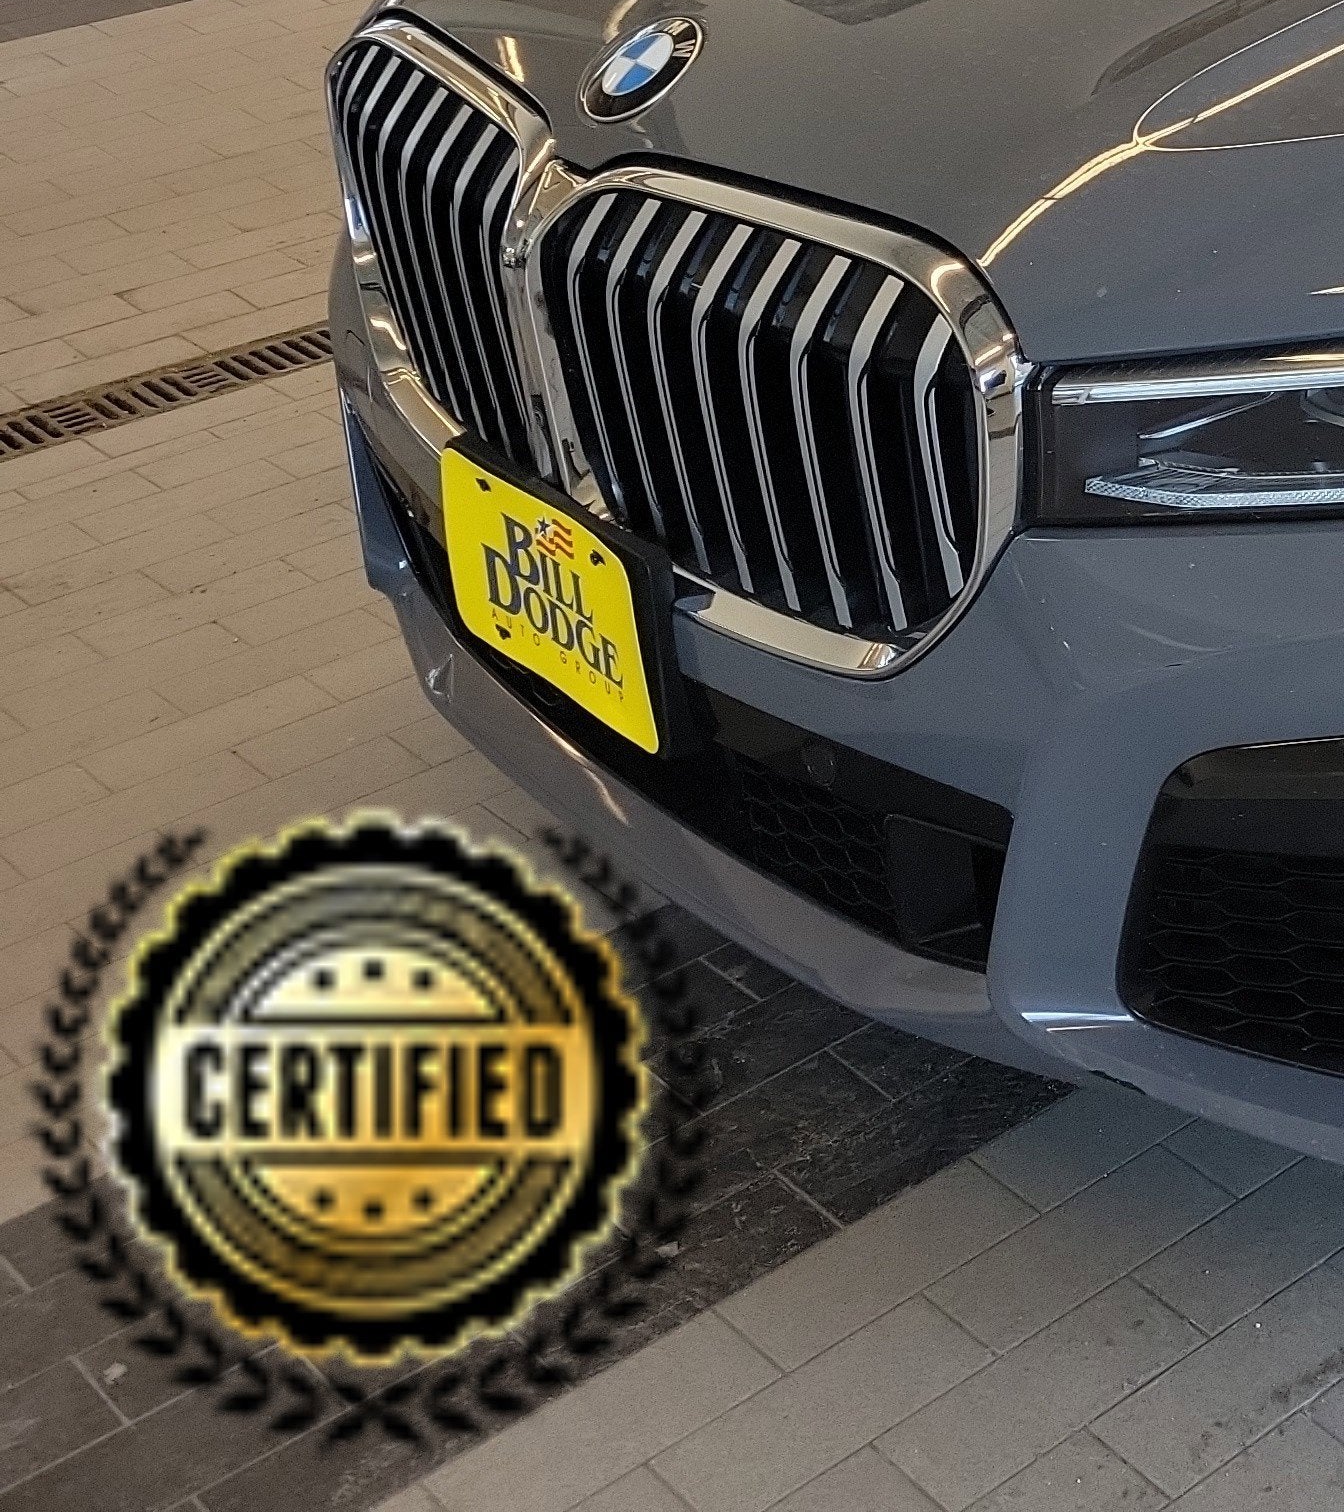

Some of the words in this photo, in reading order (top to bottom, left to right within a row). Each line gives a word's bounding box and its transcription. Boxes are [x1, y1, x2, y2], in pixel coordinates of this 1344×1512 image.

[480, 542, 624, 690] DODGE
[501, 511, 593, 626] BILL
[491, 608, 541, 647] AUTO
[559, 650, 625, 703] GROUP
